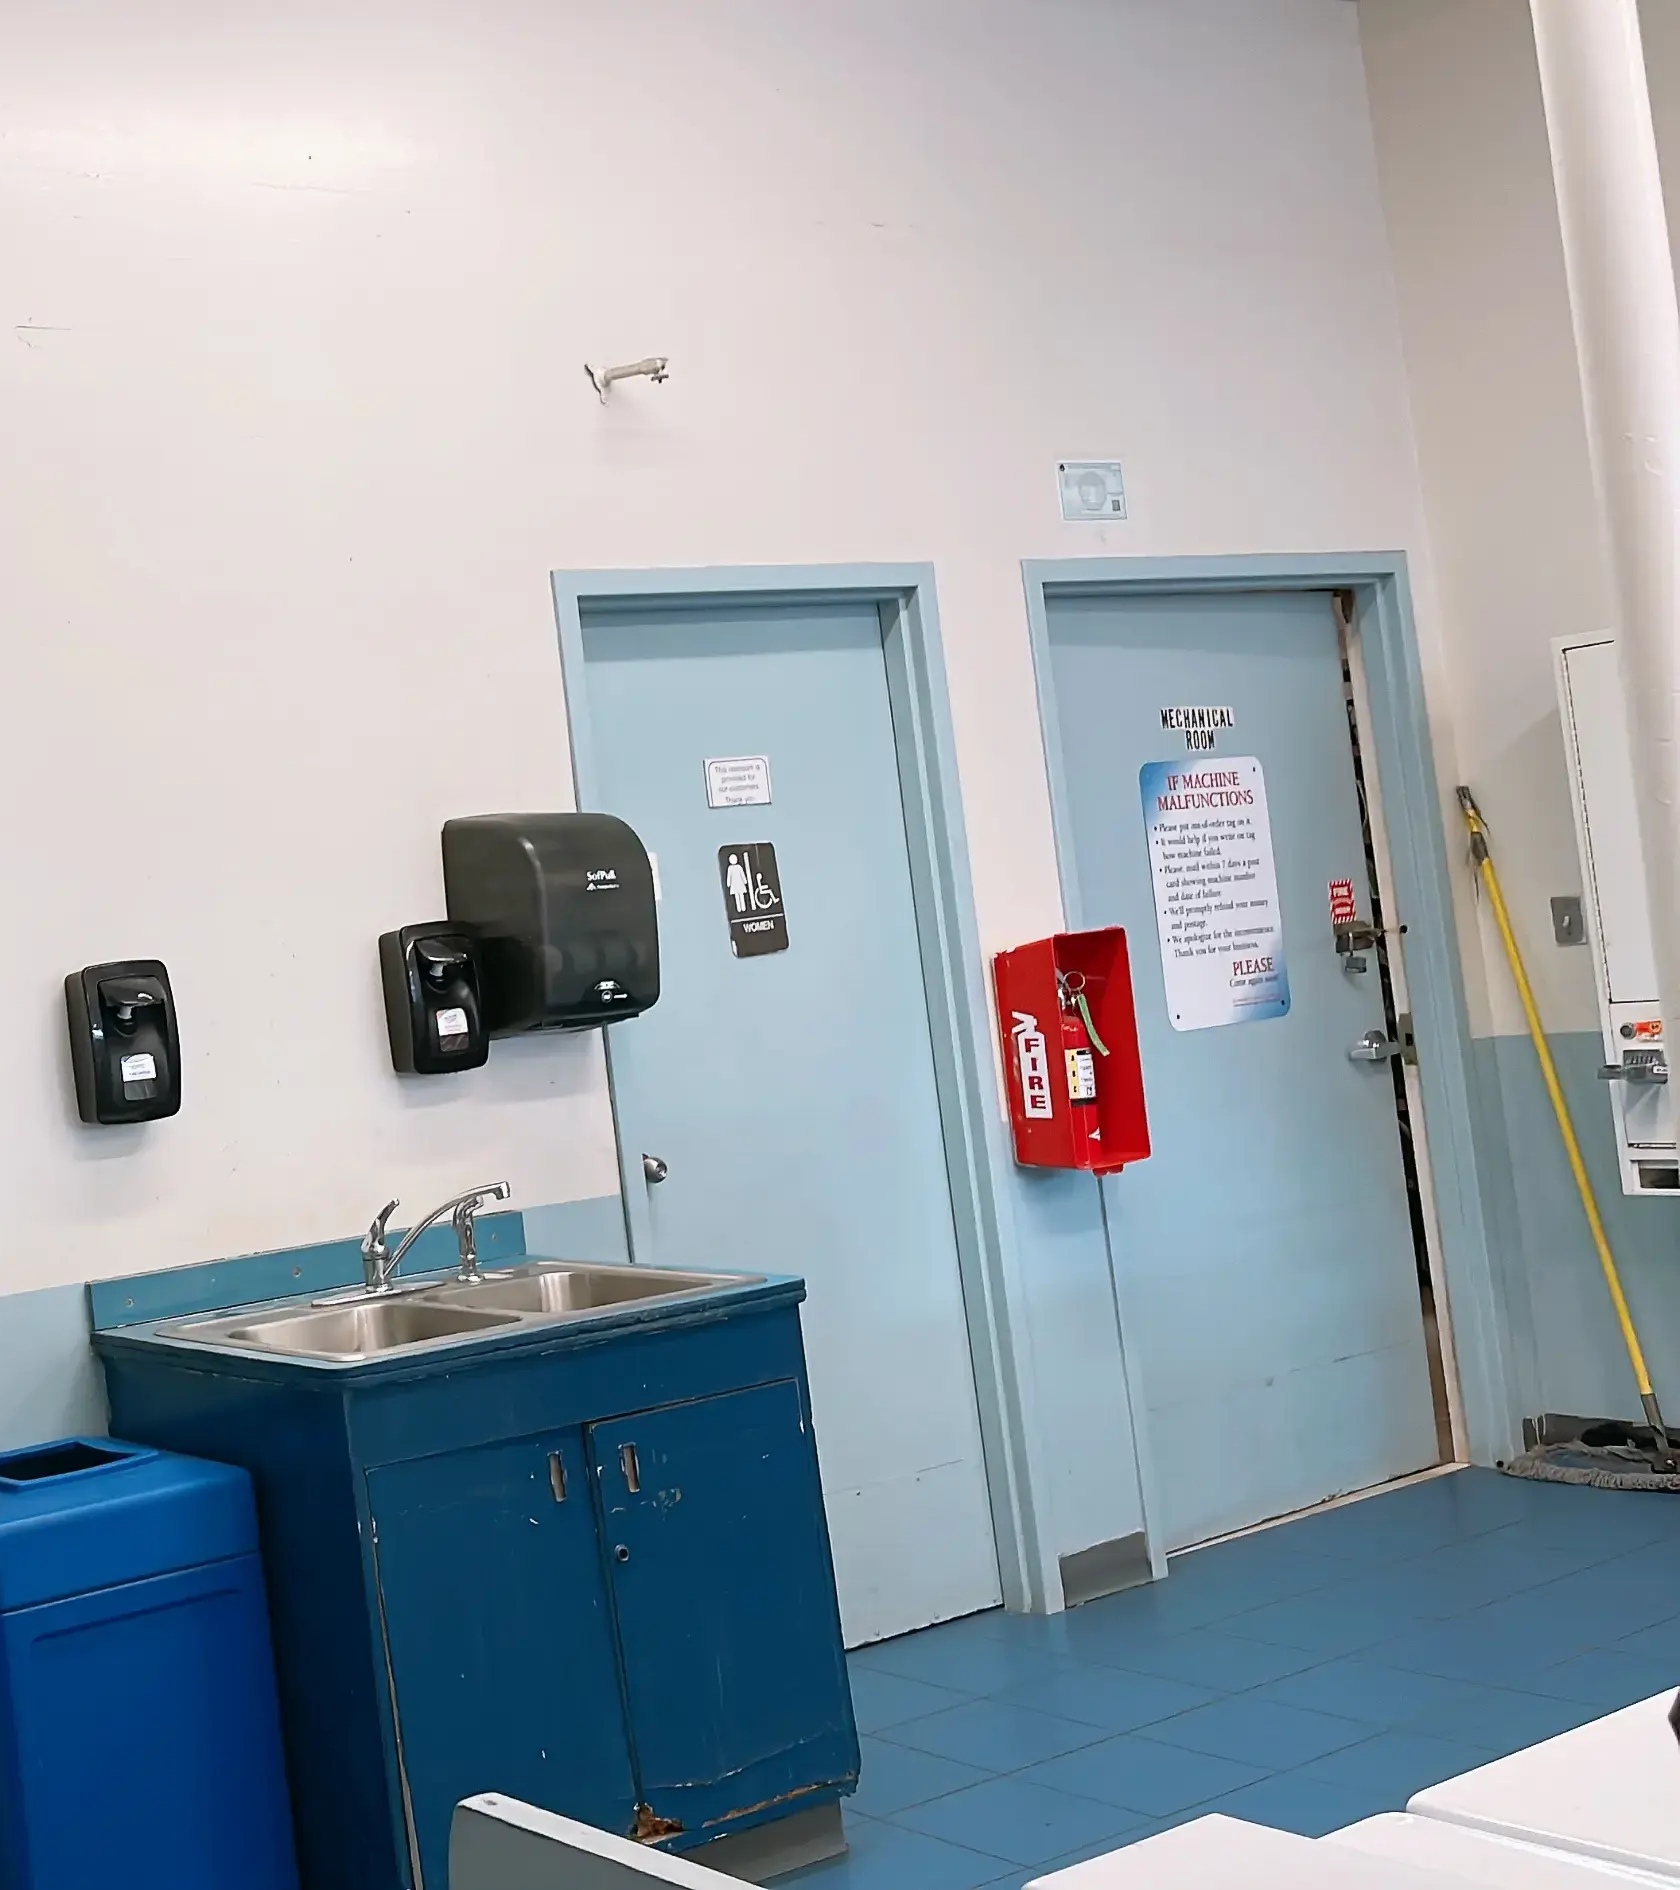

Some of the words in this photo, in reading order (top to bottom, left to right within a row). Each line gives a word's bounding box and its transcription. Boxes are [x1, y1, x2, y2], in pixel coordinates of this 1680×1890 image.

[1160, 708, 1233, 729] MECHANICAL
[1186, 730, 1215, 750] ROOM
[1168, 775, 1179, 791] IF
[1182, 772, 1240, 790] MACHINE
[1157, 790, 1254, 811] MALFUNCTIONS
[1160, 823, 1178, 833] Please
[1246, 832, 1256, 842] tag
[743, 920, 775, 933] WOMEN
[1232, 957, 1274, 976] PLEASE
[1024, 1038, 1047, 1110] FIRE
